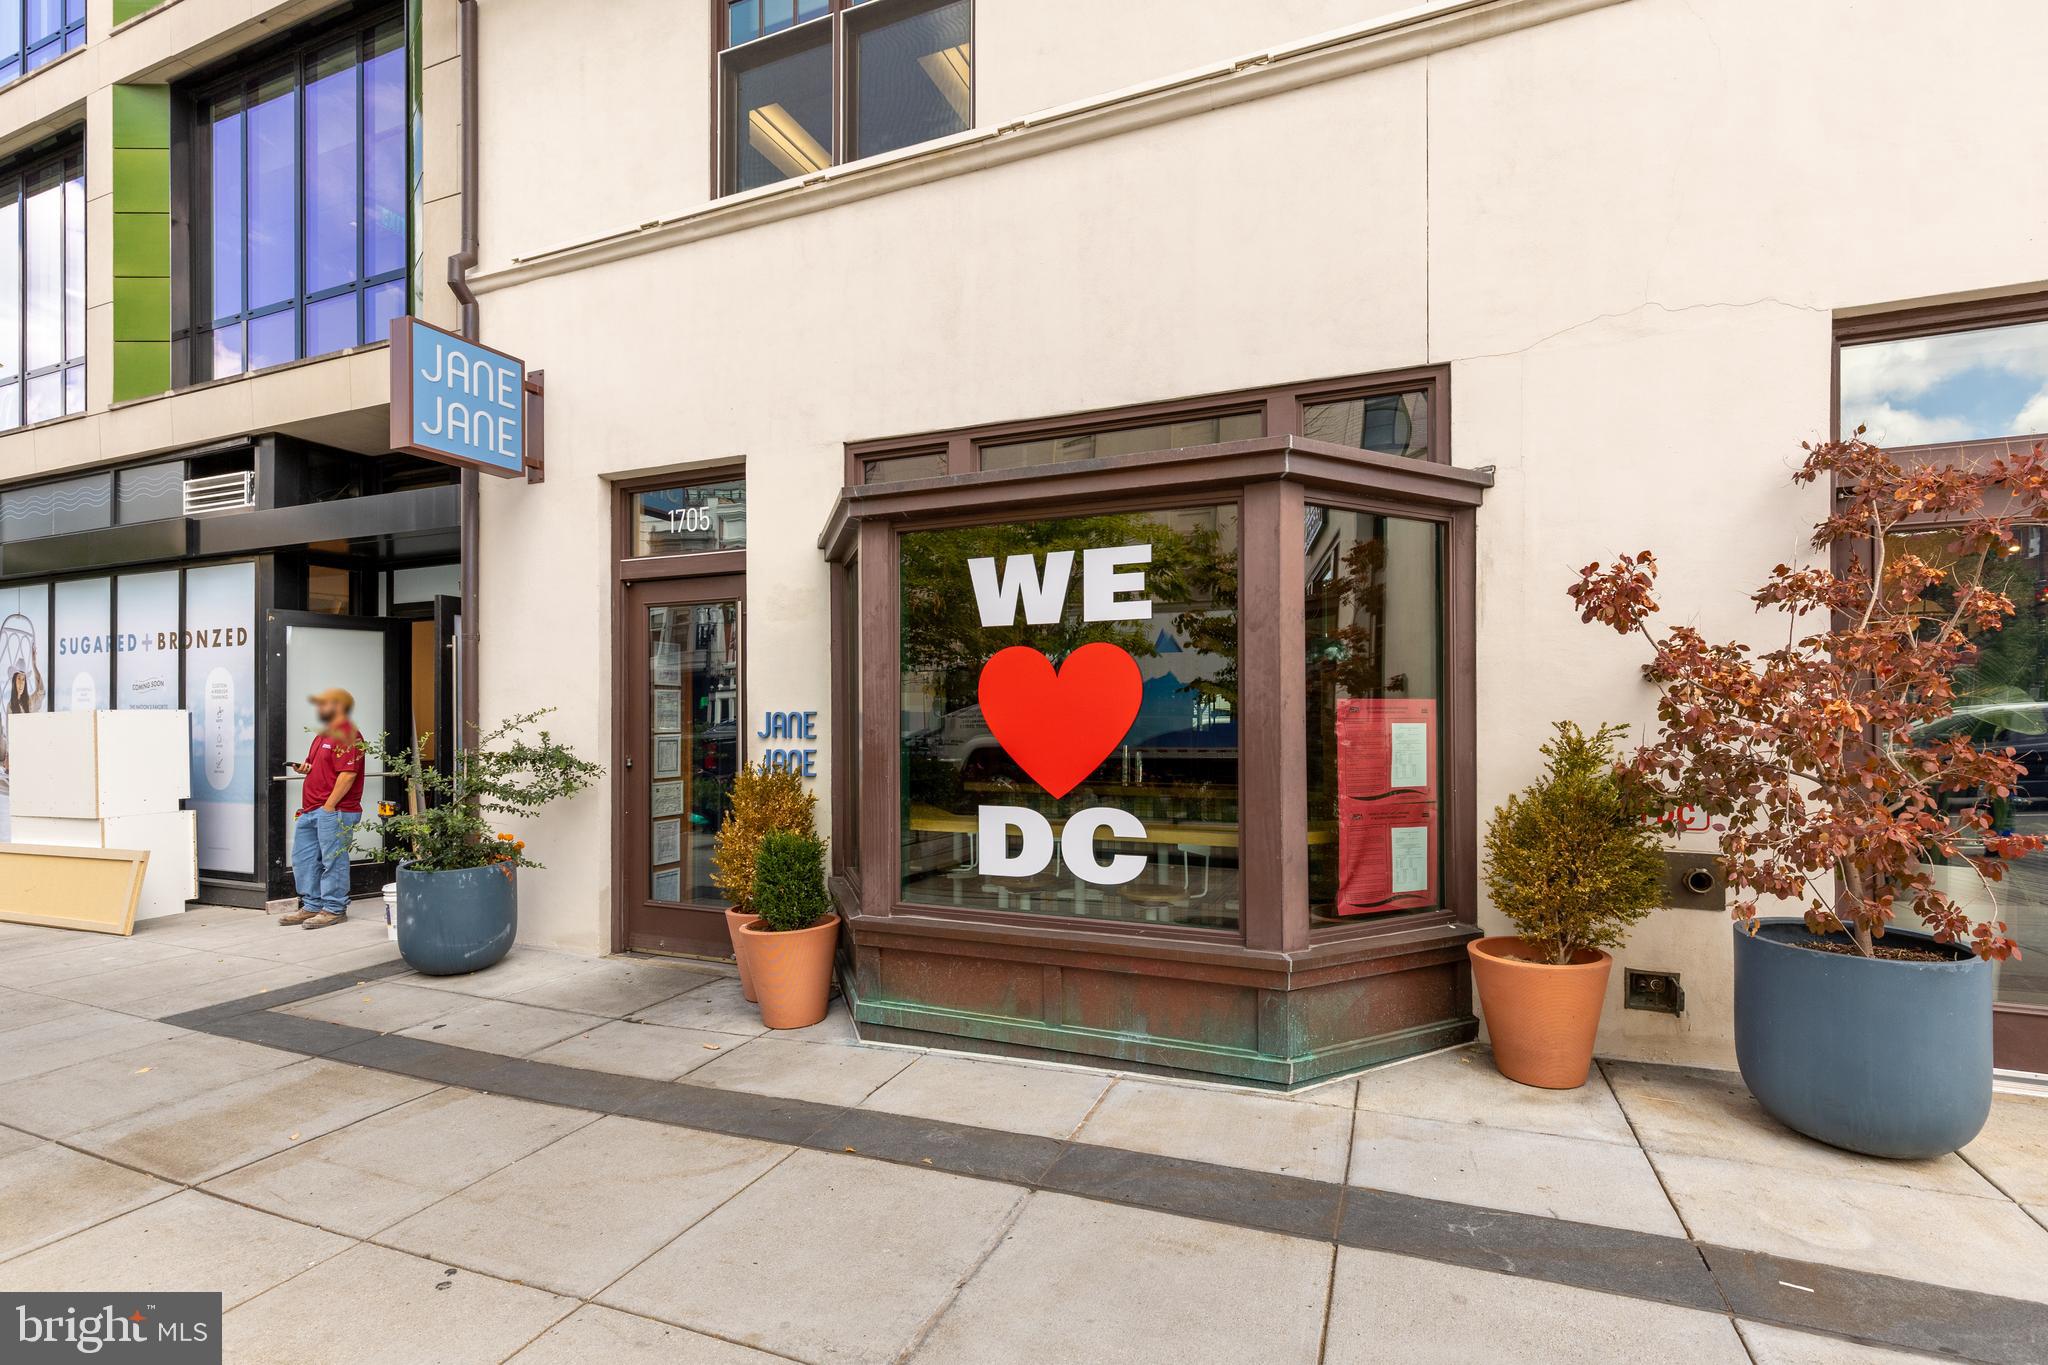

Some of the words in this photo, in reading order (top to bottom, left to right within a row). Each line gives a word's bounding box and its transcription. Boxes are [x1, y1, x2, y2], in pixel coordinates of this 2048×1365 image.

[420, 343, 517, 410] JANE
[420, 396, 517, 458] JANE
[667, 506, 710, 534] 1705
[967, 544, 1152, 627] WE
[158, 627, 247, 650] BRONZED
[757, 711, 817, 740] JANE
[978, 805, 1148, 884] DC
